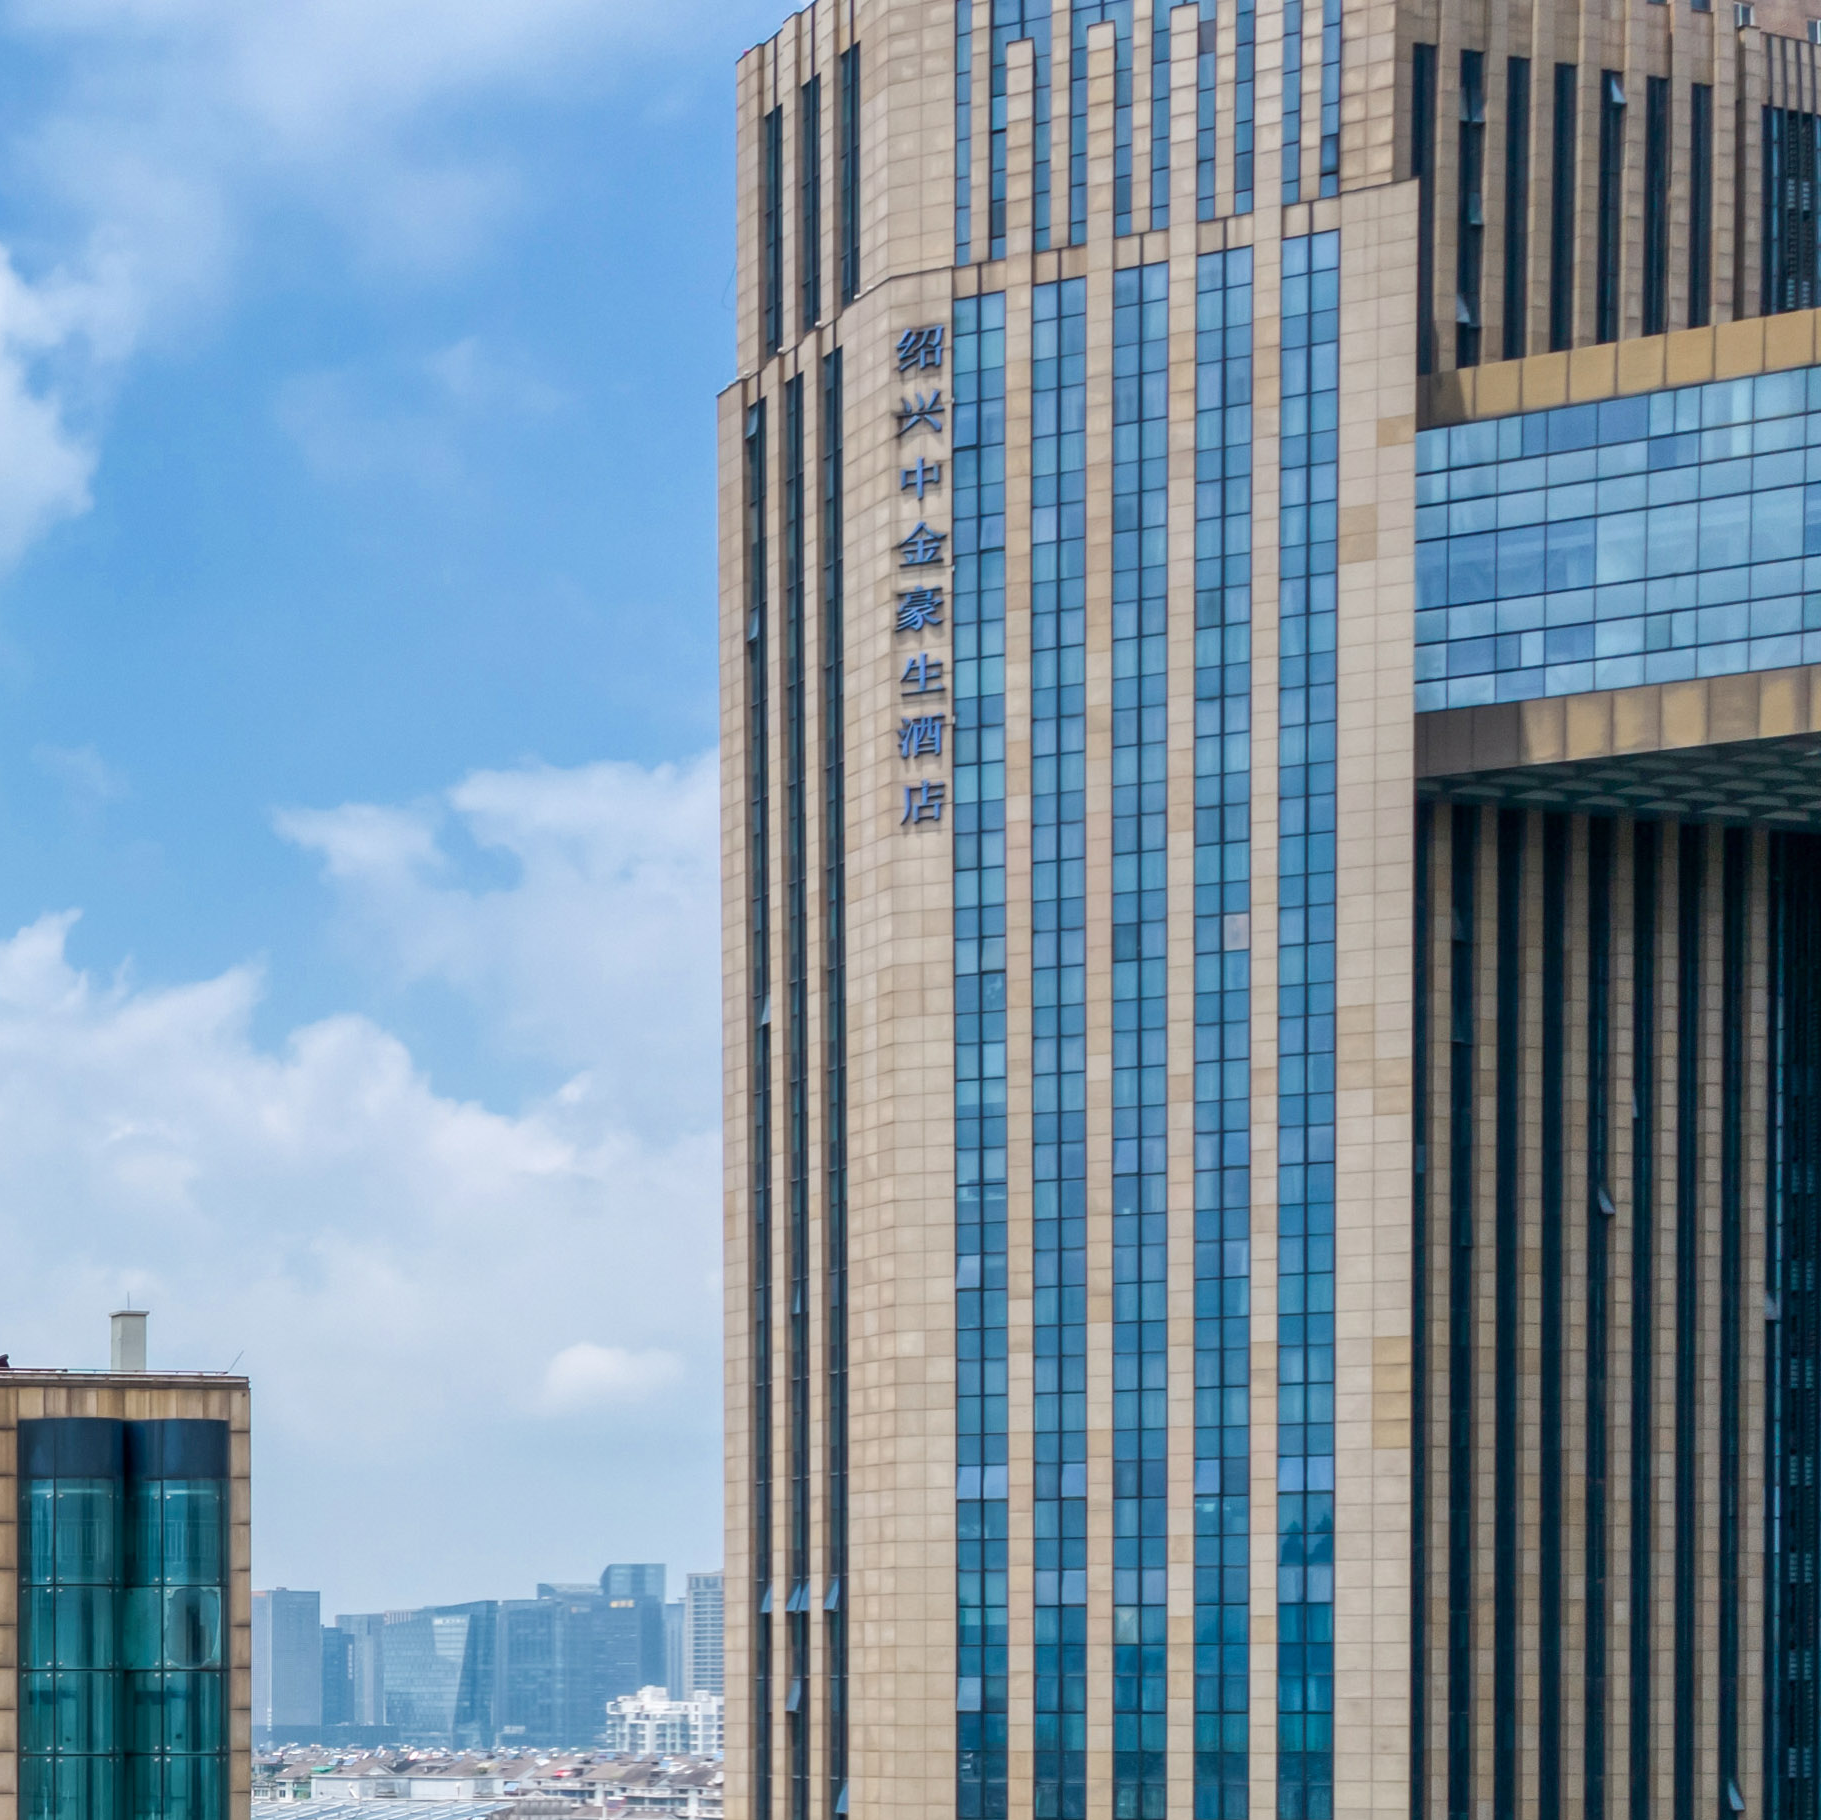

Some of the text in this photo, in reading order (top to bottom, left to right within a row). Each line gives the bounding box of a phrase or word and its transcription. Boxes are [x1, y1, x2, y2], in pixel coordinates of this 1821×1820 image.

[894, 323, 947, 826] 绍兴中金豪生酒店
